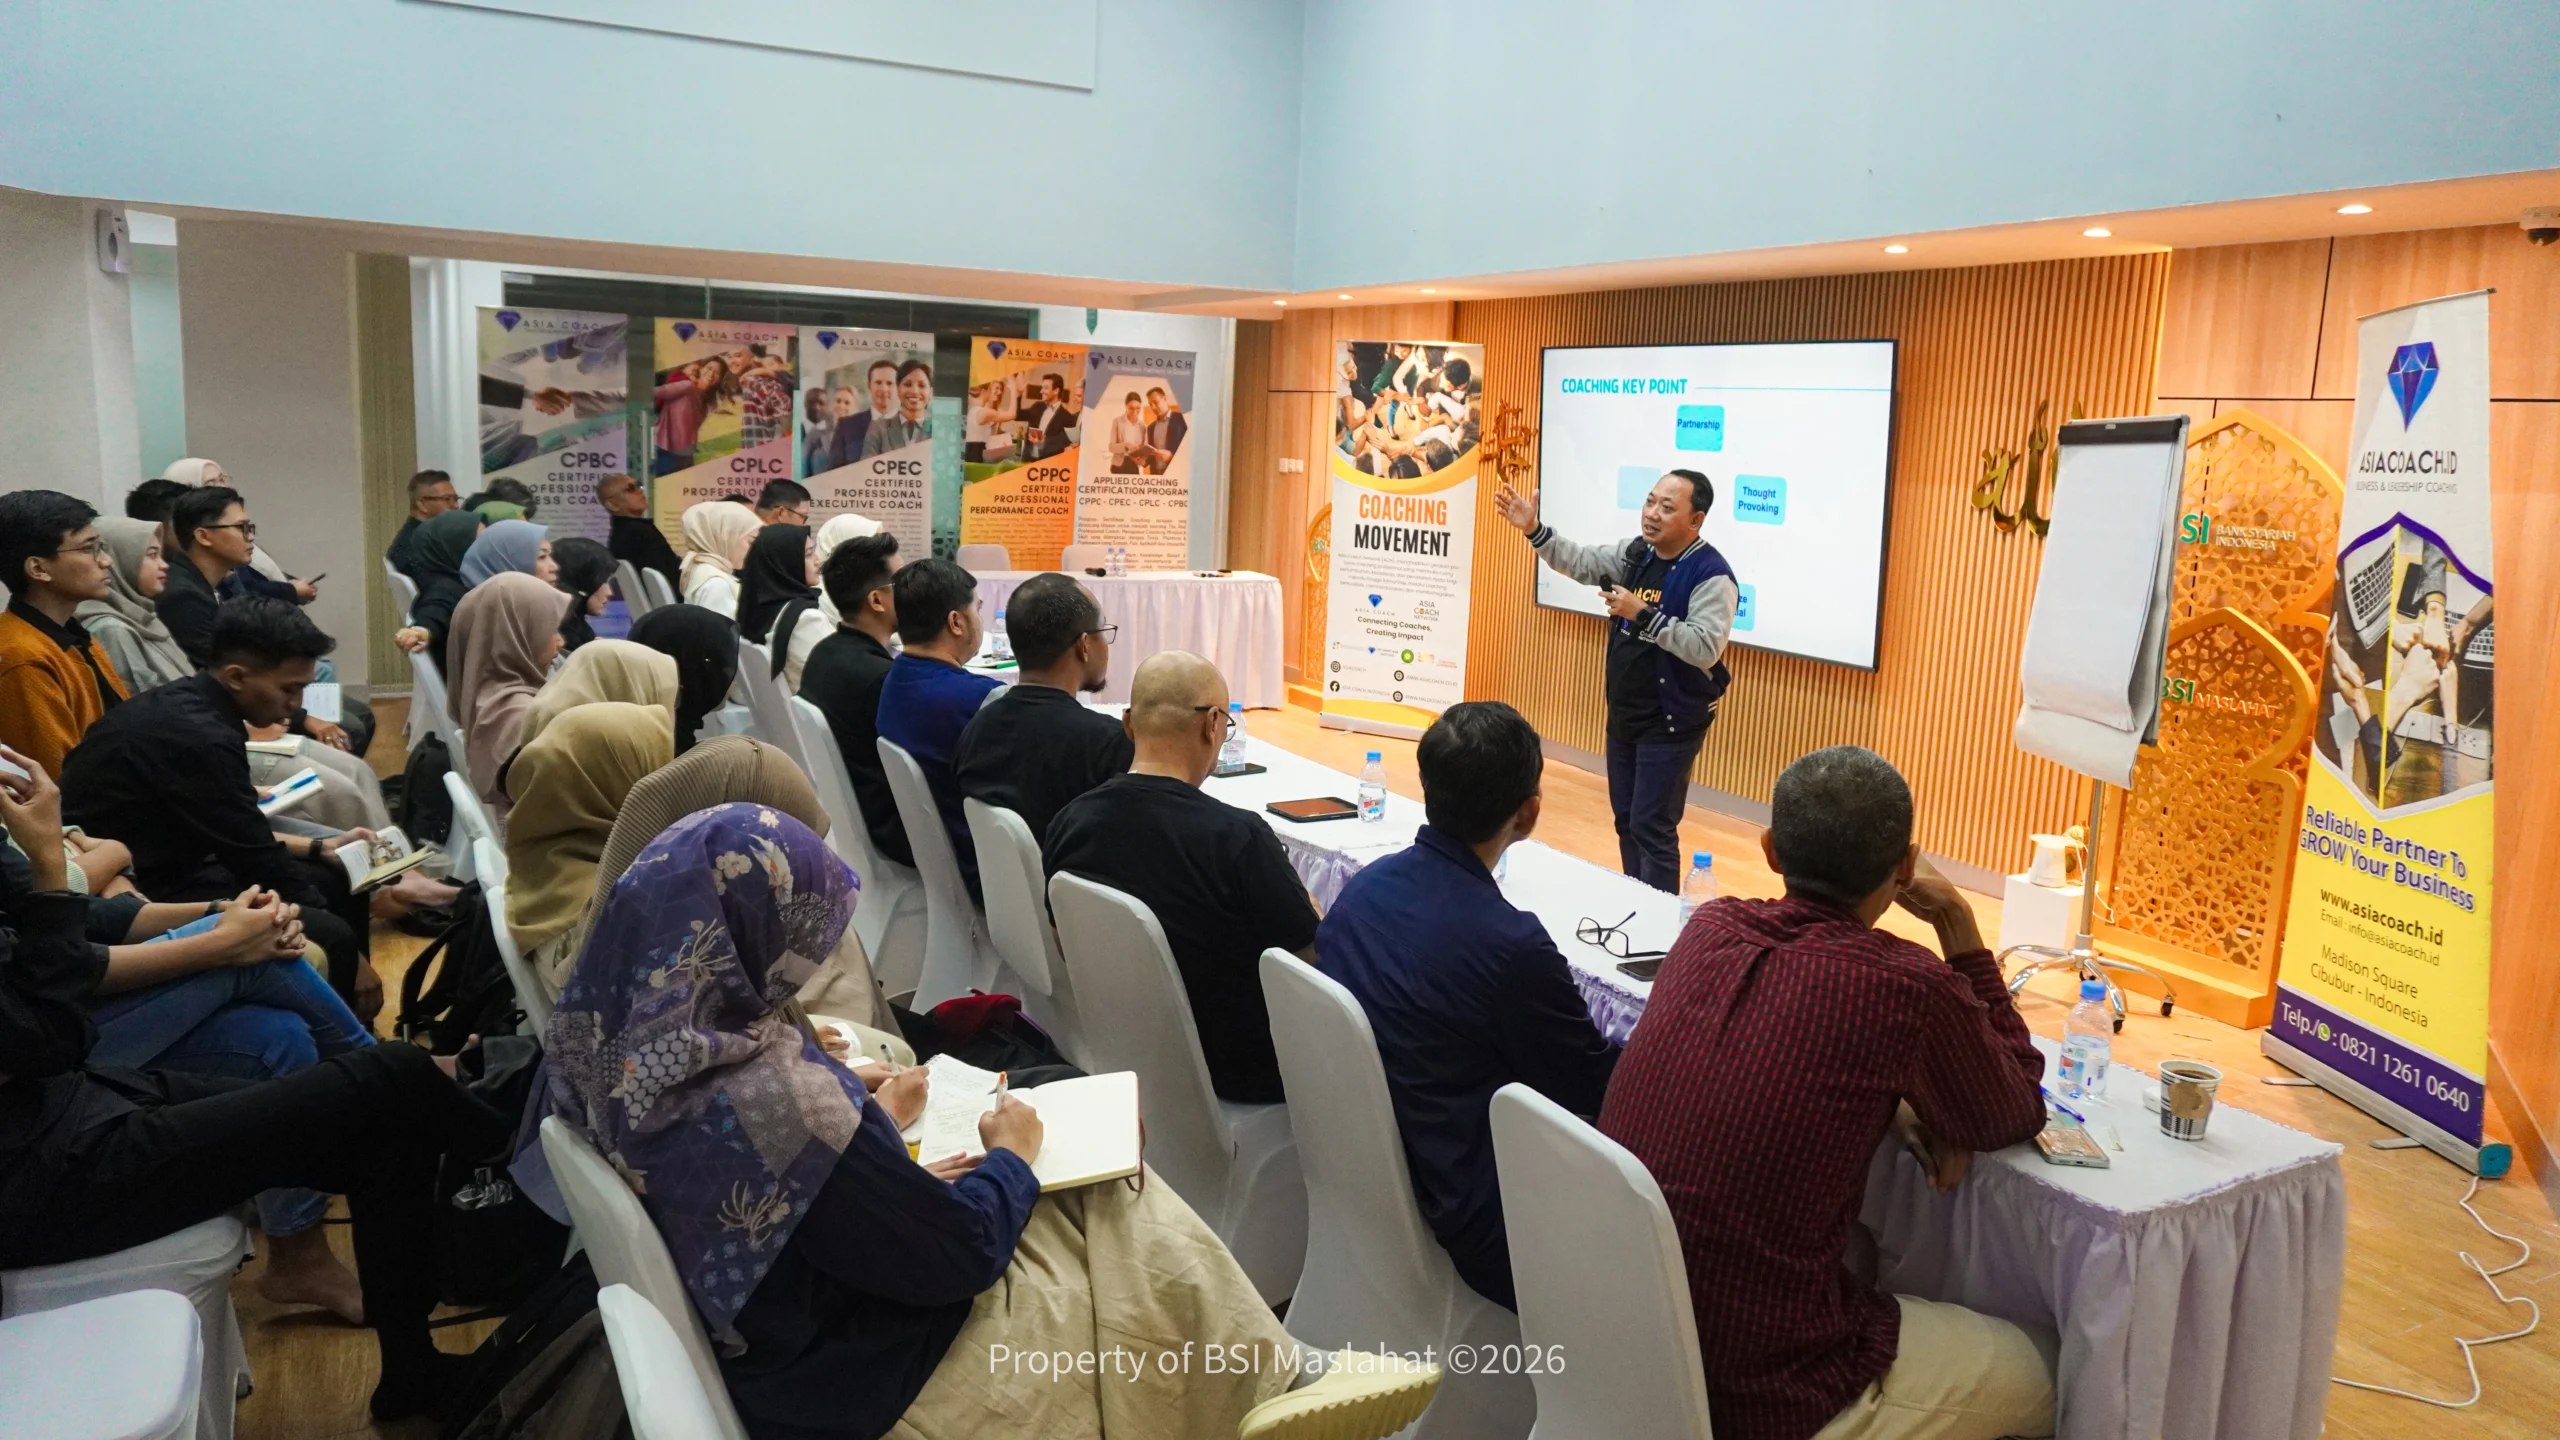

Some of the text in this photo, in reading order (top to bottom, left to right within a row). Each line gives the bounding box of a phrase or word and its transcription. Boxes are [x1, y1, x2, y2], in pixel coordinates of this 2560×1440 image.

[523, 320, 554, 329] ASIA
[698, 331, 779, 341] ASIA COACH
[841, 339, 868, 347] ASIA
[875, 340, 917, 349] COACH
[1007, 349, 1074, 360] ASIA COACH
[1107, 356, 1192, 369] ASIA COACH
[1561, 378, 1688, 394] COACHING KEY POINT
[1677, 418, 1720, 431] Partnership
[560, 452, 617, 468] CPBC
[731, 458, 783, 474] CPLC
[2359, 450, 2457, 474] ASIACOACH.ID
[872, 460, 922, 475] CPEC
[1027, 467, 1071, 482] CPPC
[717, 477, 770, 486] CERTIFI
[865, 479, 922, 488] CERTIFIED
[1093, 476, 1178, 487] APPLIED COACHING
[682, 487, 759, 497] PROFESSIO
[835, 489, 922, 499] PROFESSIONAL
[1021, 485, 1070, 494] CERTIFIED
[1078, 485, 1189, 496] CERTIFICATION PROGRAM
[1743, 486, 1776, 500] Thought
[568, 496, 599, 505] COA
[810, 499, 922, 510] EXECUTIVE COACH
[994, 495, 1069, 504] PROFESSIONAL
[1079, 497, 1101, 506] CPPC
[1108, 498, 1131, 506] CPEC
[1139, 499, 1160, 507] CPLC
[1168, 500, 1188, 508] CPBC
[970, 506, 1069, 515] PERFORMANCE COACH
[1359, 493, 1447, 526] COACHING
[1738, 500, 1779, 515] Provoking
[2180, 514, 2210, 545] SI
[2216, 524, 2297, 541] BANK SYARIAH
[1354, 524, 1451, 557] MOVEMENT
[2216, 536, 2276, 551] INDONESIA
[1419, 600, 1435, 608] ASIA
[1357, 616, 1433, 632] Connecting Coaches,
[1366, 628, 1424, 641] Creating Impact
[2162, 677, 2280, 719] BSI MASLAHAT
[2305, 805, 2467, 879] Reliable Partner To
[2300, 828, 2475, 911] GROW Your Business
[2320, 889, 2444, 946] www.asiacoach.id
[2321, 909, 2343, 929] Email
[2348, 921, 2440, 967] info@asiacoach.id
[2321, 944, 2419, 999] Madison Square
[2310, 963, 2355, 996] Cibubur
[2365, 987, 2428, 1028] Indonesia
[2340, 1032, 2376, 1066] 0821
[2383, 1054, 2421, 1088] 1261
[2426, 1075, 2470, 1112] 0640
